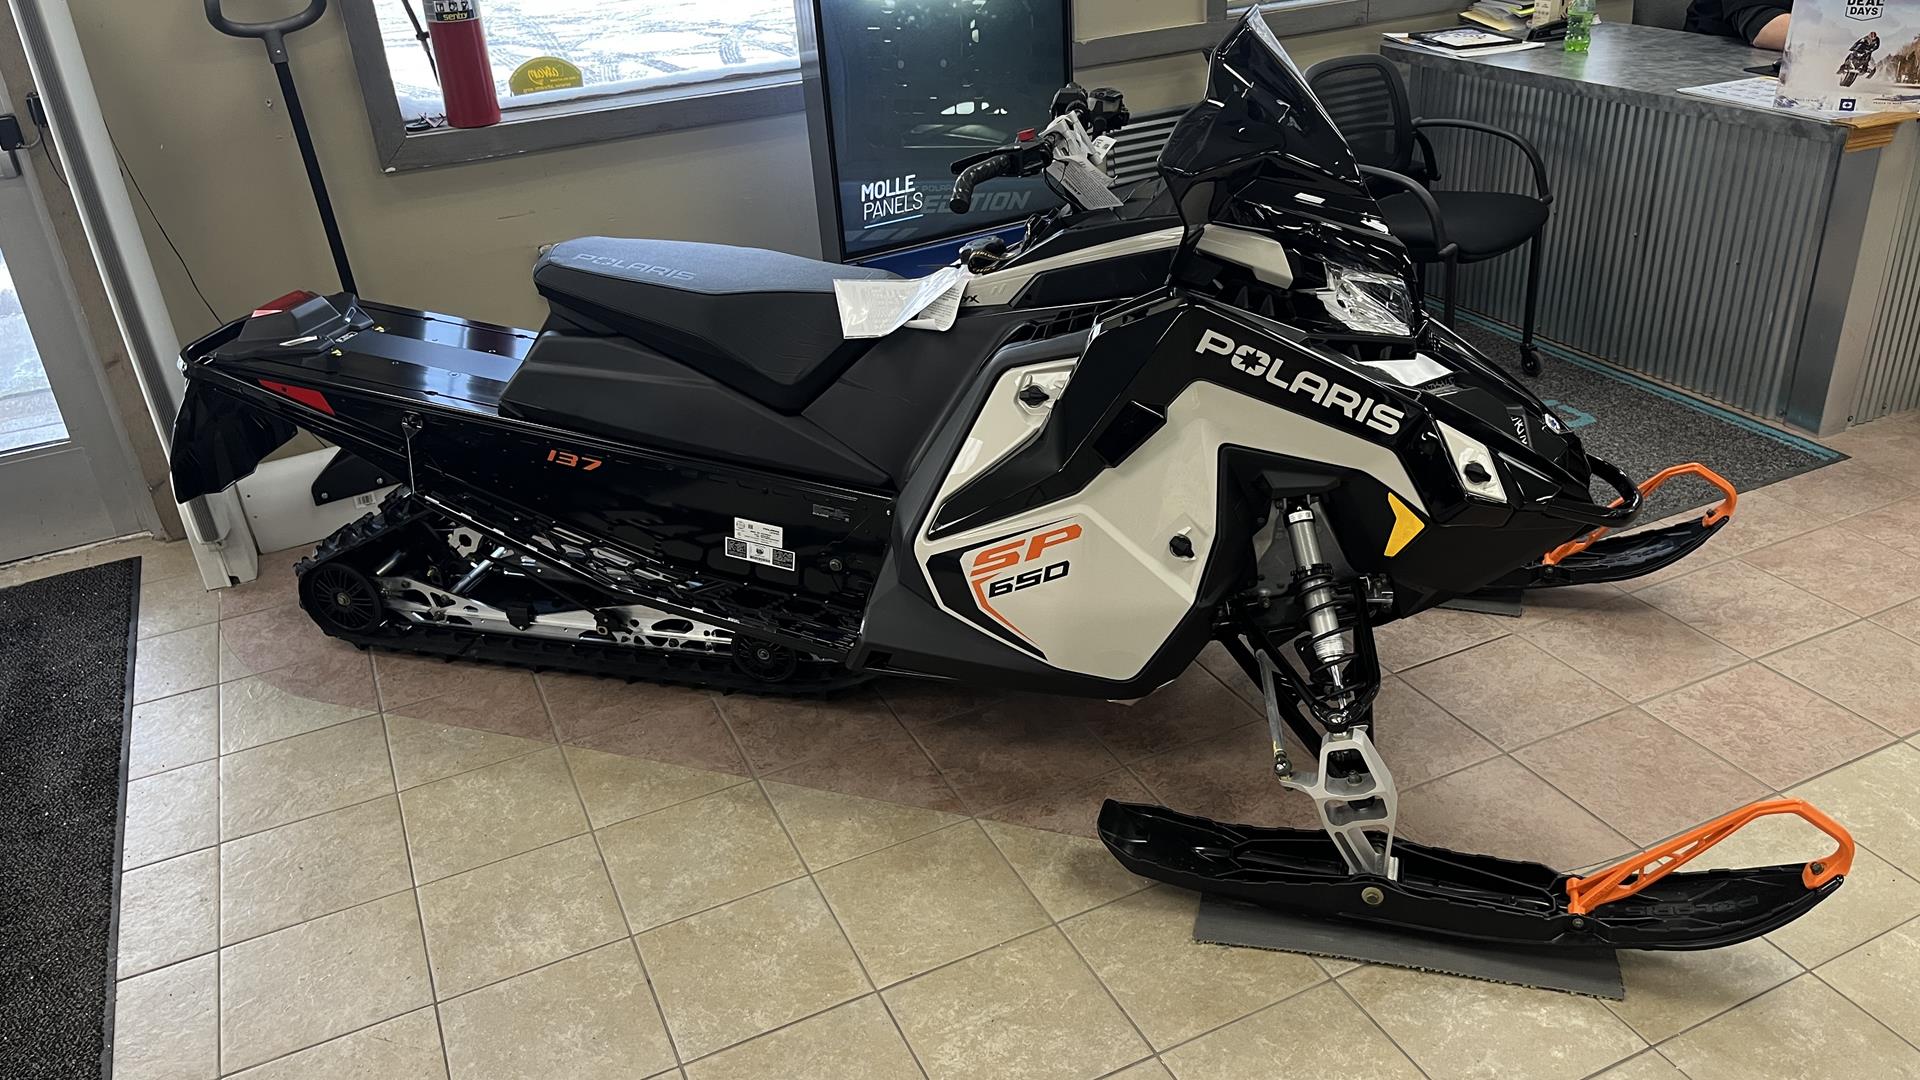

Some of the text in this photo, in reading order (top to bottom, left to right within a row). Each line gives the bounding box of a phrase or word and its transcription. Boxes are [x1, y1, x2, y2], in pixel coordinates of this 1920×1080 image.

[442, 11, 468, 21] sentry
[1849, 6, 1879, 16] DAYS
[861, 173, 916, 202] MOLLE
[863, 191, 924, 221] PANELS
[920, 190, 1032, 214] EDTION
[572, 253, 697, 281] POLARIS
[1195, 328, 1405, 436] POLARIS
[546, 449, 603, 471] 137
[969, 523, 1083, 578] SP
[988, 559, 1071, 599] 650
